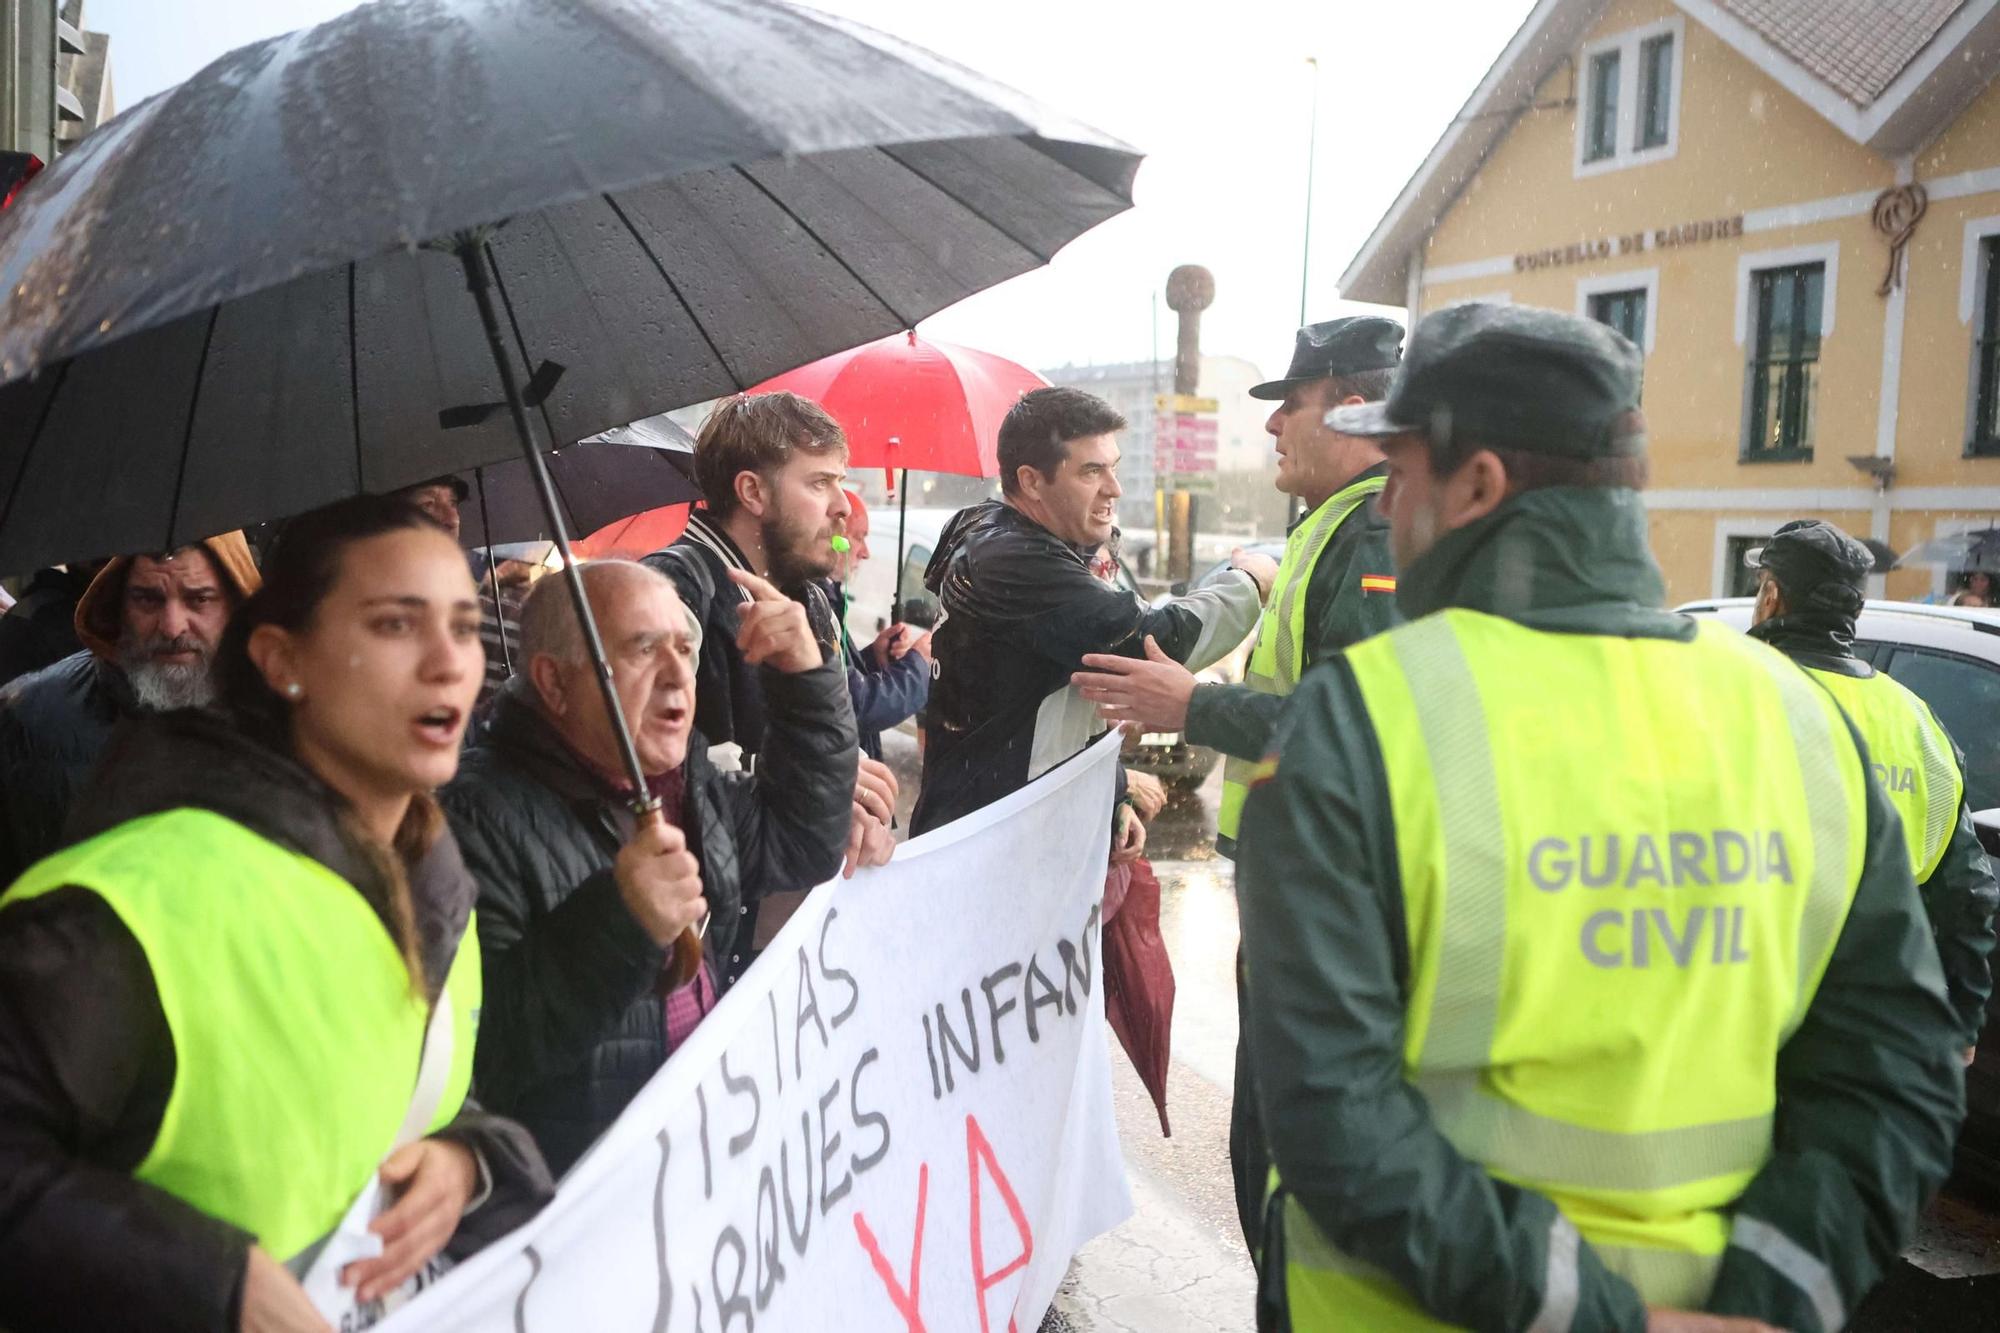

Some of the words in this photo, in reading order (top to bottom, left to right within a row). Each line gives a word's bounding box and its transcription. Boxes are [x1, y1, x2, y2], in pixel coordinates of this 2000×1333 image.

[1514, 240, 1610, 272] CONCELLO
[1620, 233, 1644, 254] DE
[1527, 829, 1794, 893] GUARDIA
[1580, 906, 1749, 968] CIVIL
